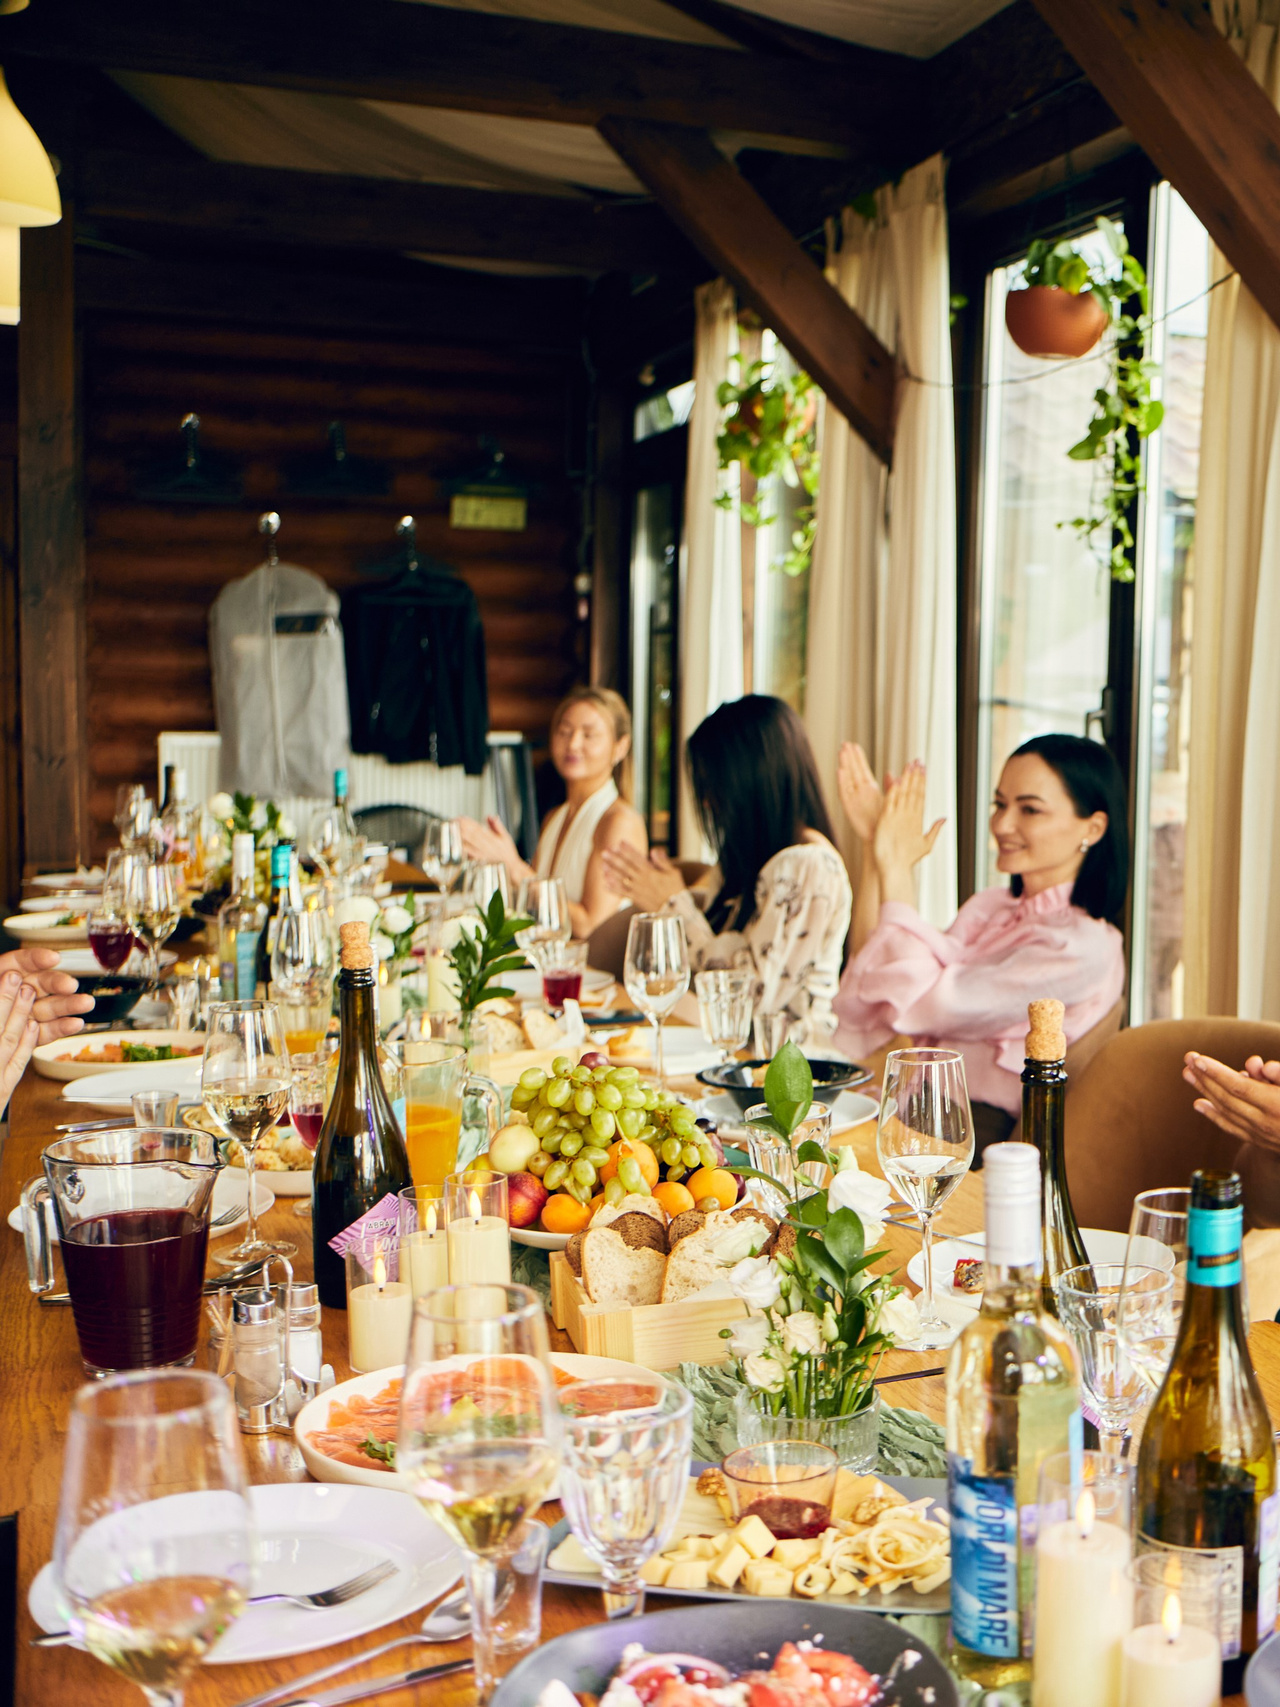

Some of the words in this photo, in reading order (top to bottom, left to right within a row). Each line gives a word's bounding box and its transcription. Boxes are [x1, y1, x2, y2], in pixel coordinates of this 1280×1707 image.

[367, 1217, 396, 1230] ABRAU
[977, 1552, 1007, 1574] DI
[977, 1578, 1008, 1648] MARE
